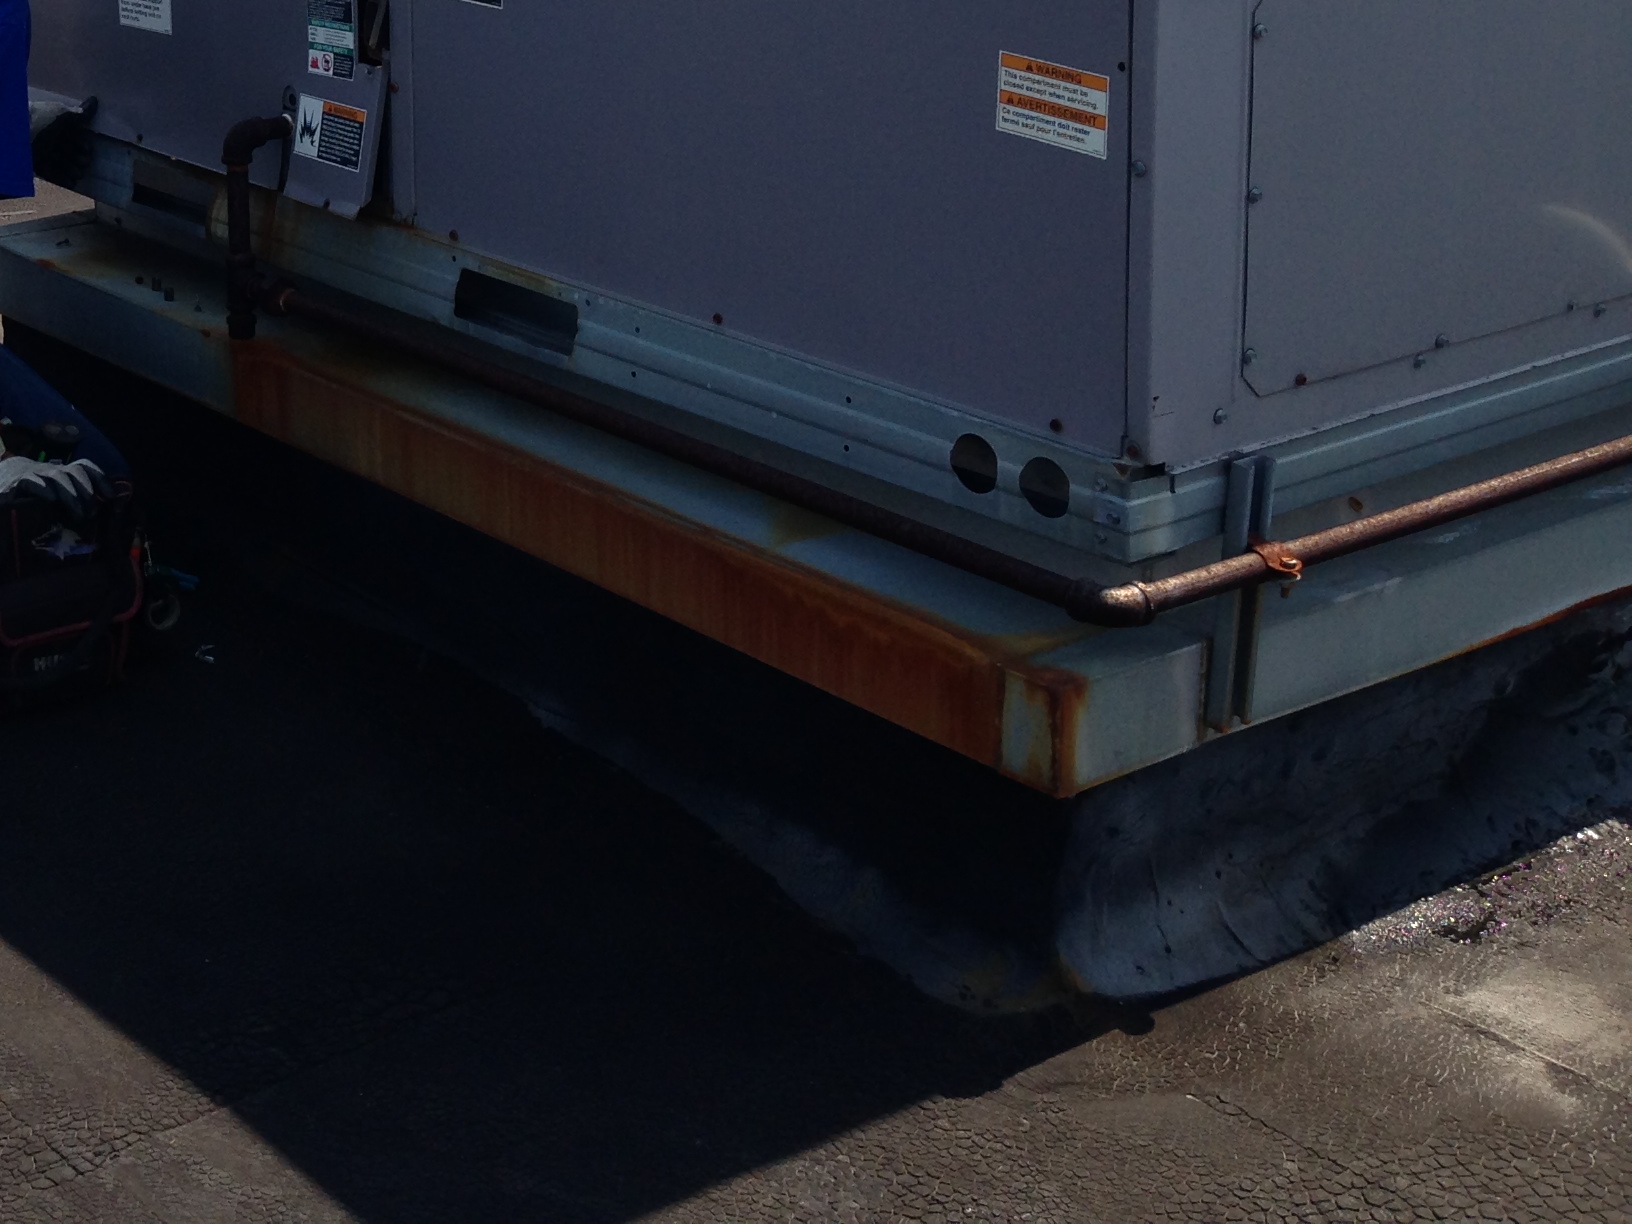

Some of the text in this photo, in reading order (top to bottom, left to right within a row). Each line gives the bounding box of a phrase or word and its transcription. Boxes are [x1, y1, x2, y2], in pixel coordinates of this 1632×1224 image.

[1004, 70, 1089, 97] This compartment must be
[1036, 64, 1082, 84] WARNING
[1004, 80, 1098, 110] closed except when servicing.
[1002, 107, 1090, 136] Ce compartiment doit rester
[1017, 97, 1097, 126] AVERTISSEMENT
[1022, 121, 1036, 131] sauf
[1036, 126, 1051, 136] pour
